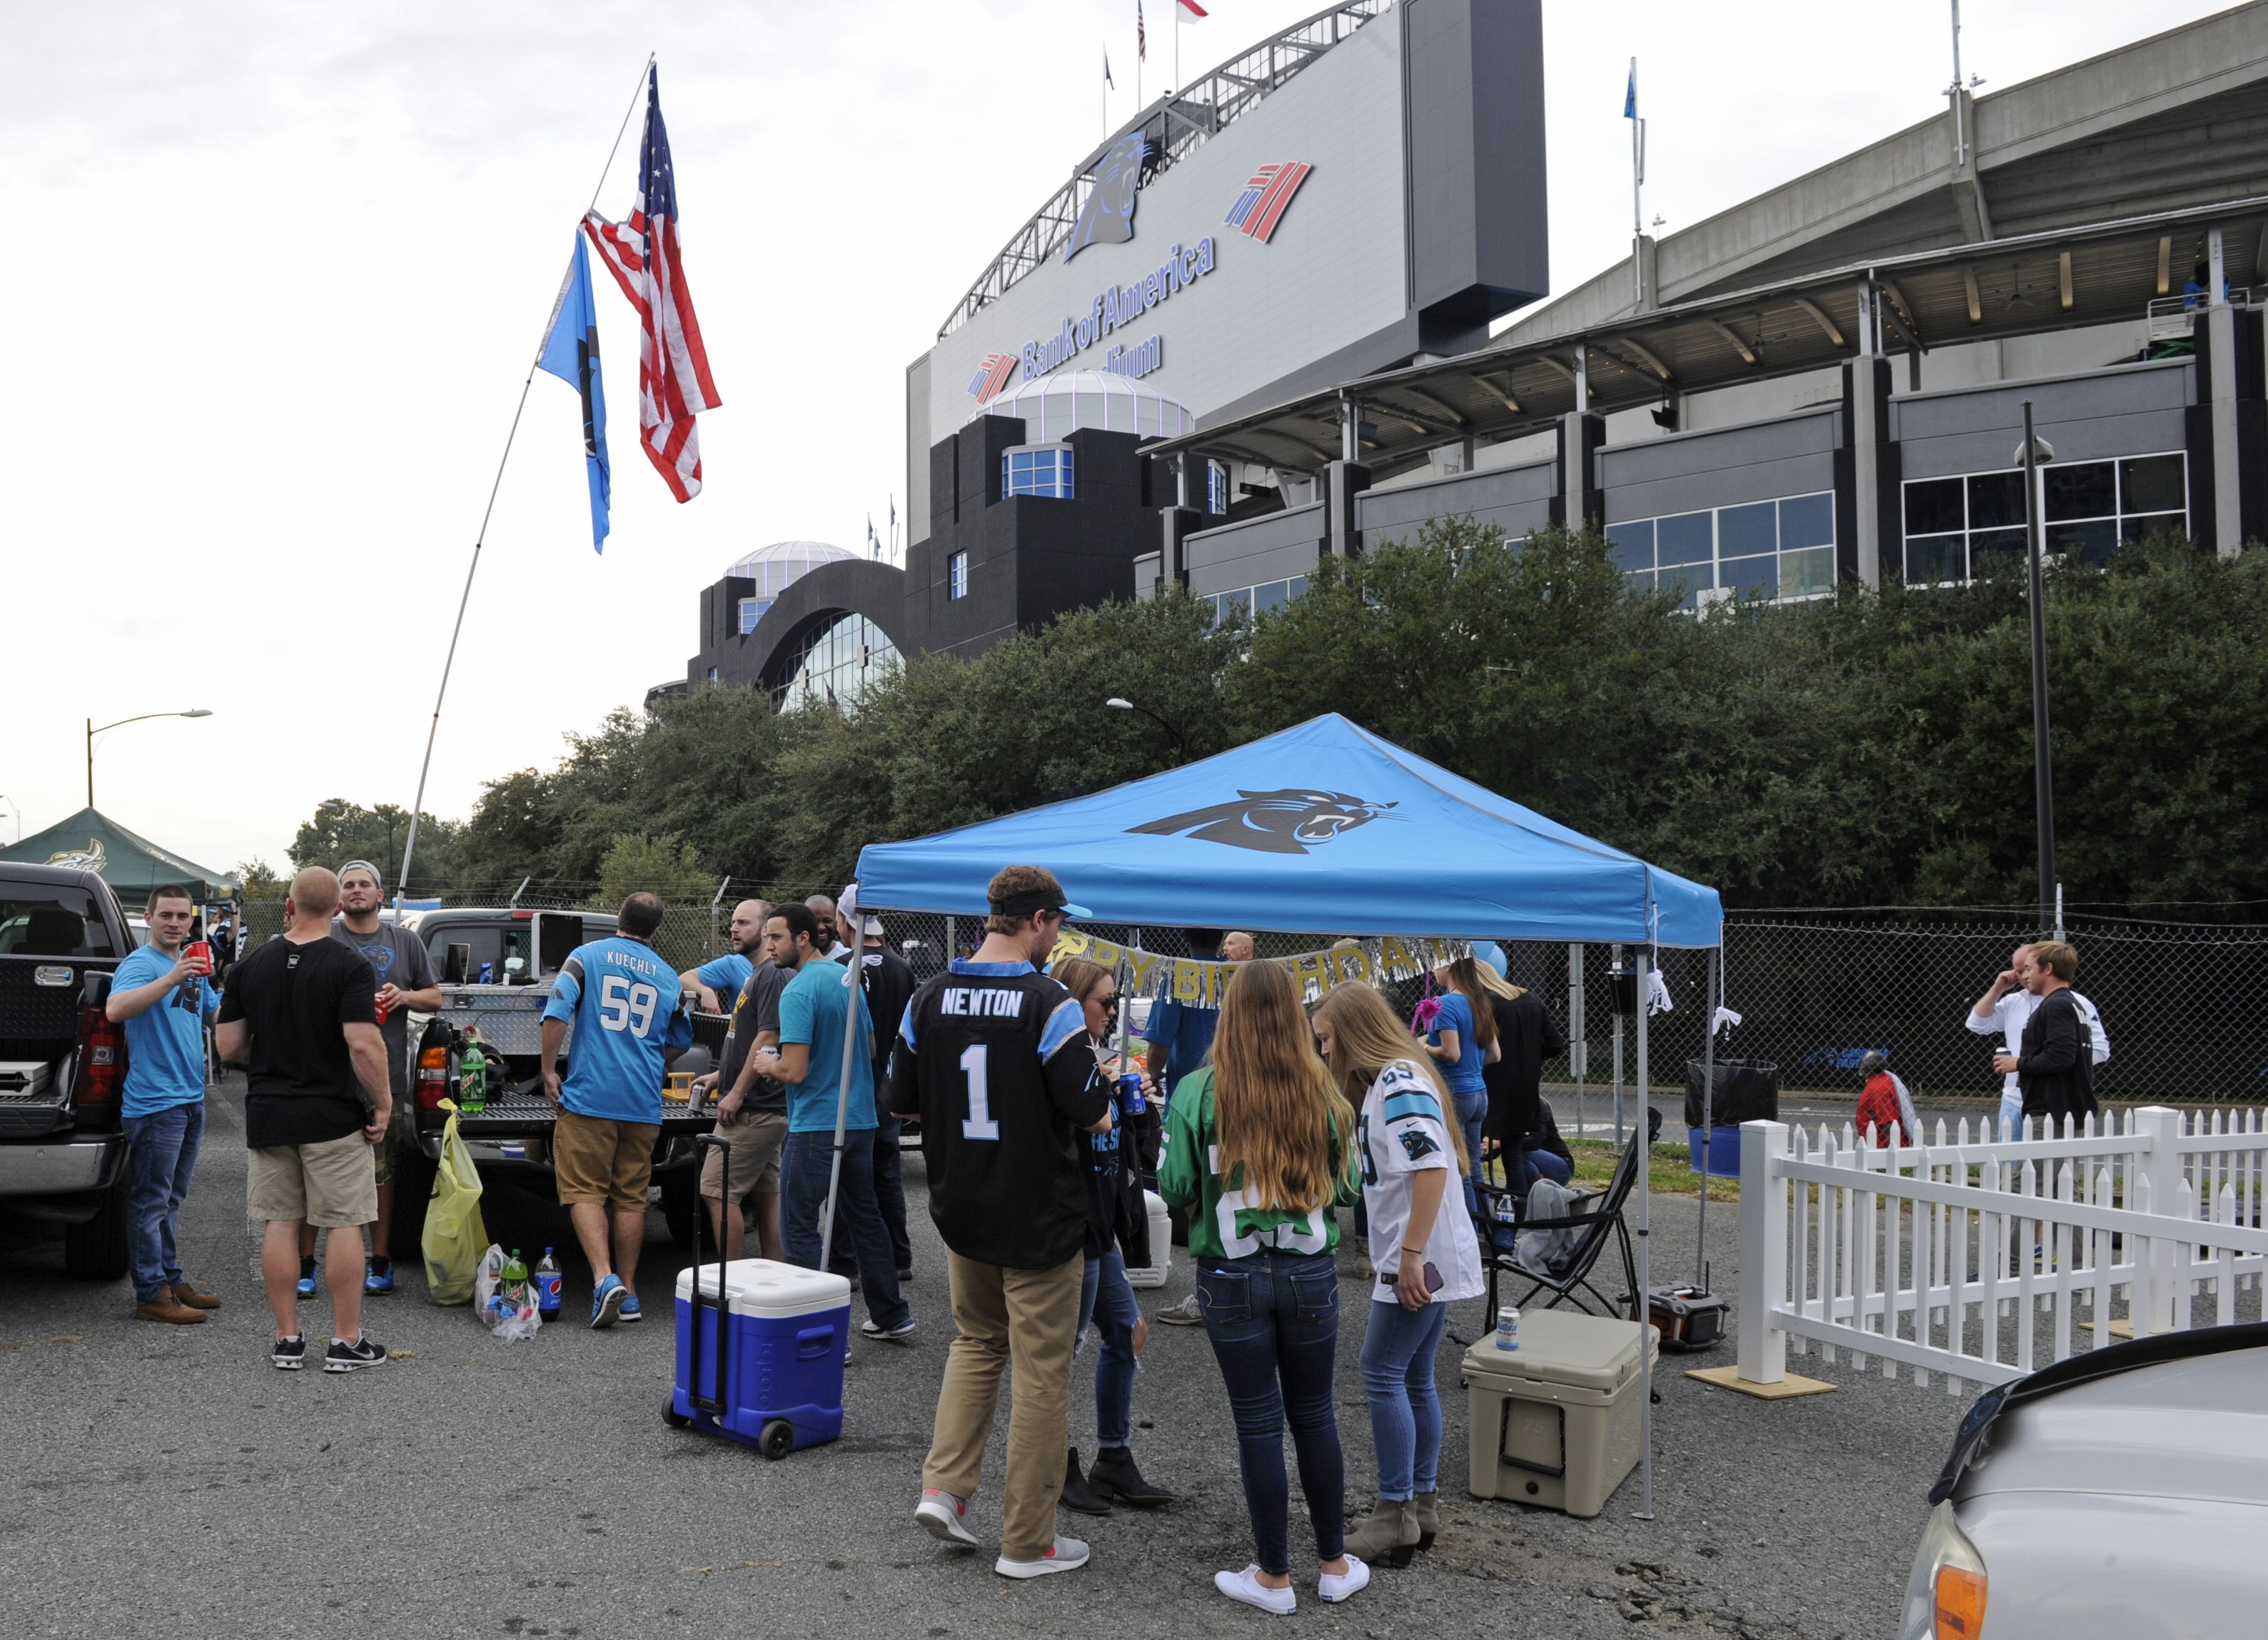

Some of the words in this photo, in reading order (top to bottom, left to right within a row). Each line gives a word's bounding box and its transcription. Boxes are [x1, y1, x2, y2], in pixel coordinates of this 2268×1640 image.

[1022, 317, 1077, 381] Bank
[1077, 293, 1102, 349] of
[1102, 235, 1215, 335] America
[1102, 334, 1162, 379] dium
[607, 951, 657, 976] KUECHLY
[1173, 937, 1445, 1002] BIHDA
[600, 974, 659, 1040] 59
[941, 987, 1024, 1018] NEWTON
[961, 1044, 999, 1141] 1
